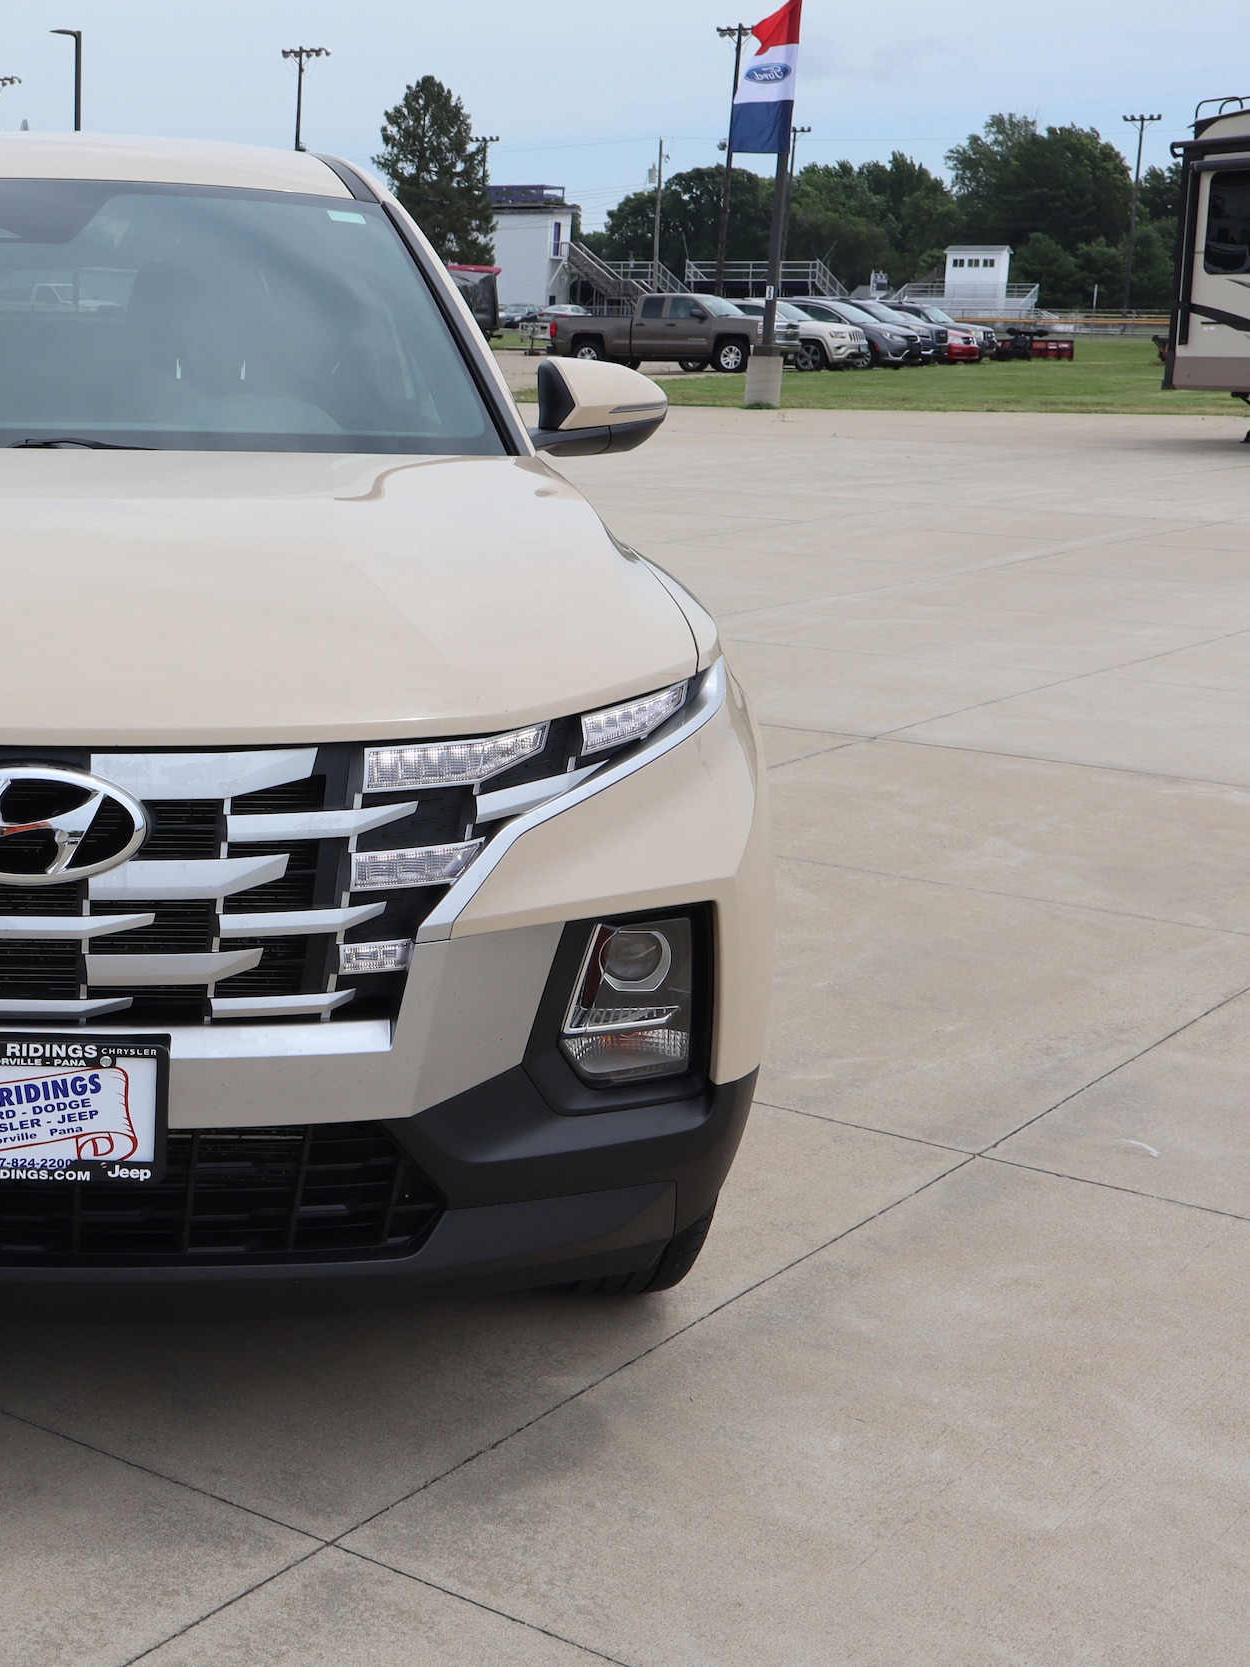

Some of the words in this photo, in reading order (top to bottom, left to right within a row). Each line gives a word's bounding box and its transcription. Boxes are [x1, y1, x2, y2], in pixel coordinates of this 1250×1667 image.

[6, 1043, 98, 1059] RIDINGS
[101, 1047, 157, 1056] CHRYSLER
[54, 1058, 87, 1067] PANA
[32, 1098, 92, 1116] DODGE
[57, 1109, 99, 1124] JEEP
[49, 1126, 83, 1137] Pana
[107, 1164, 151, 1182] Jeep
